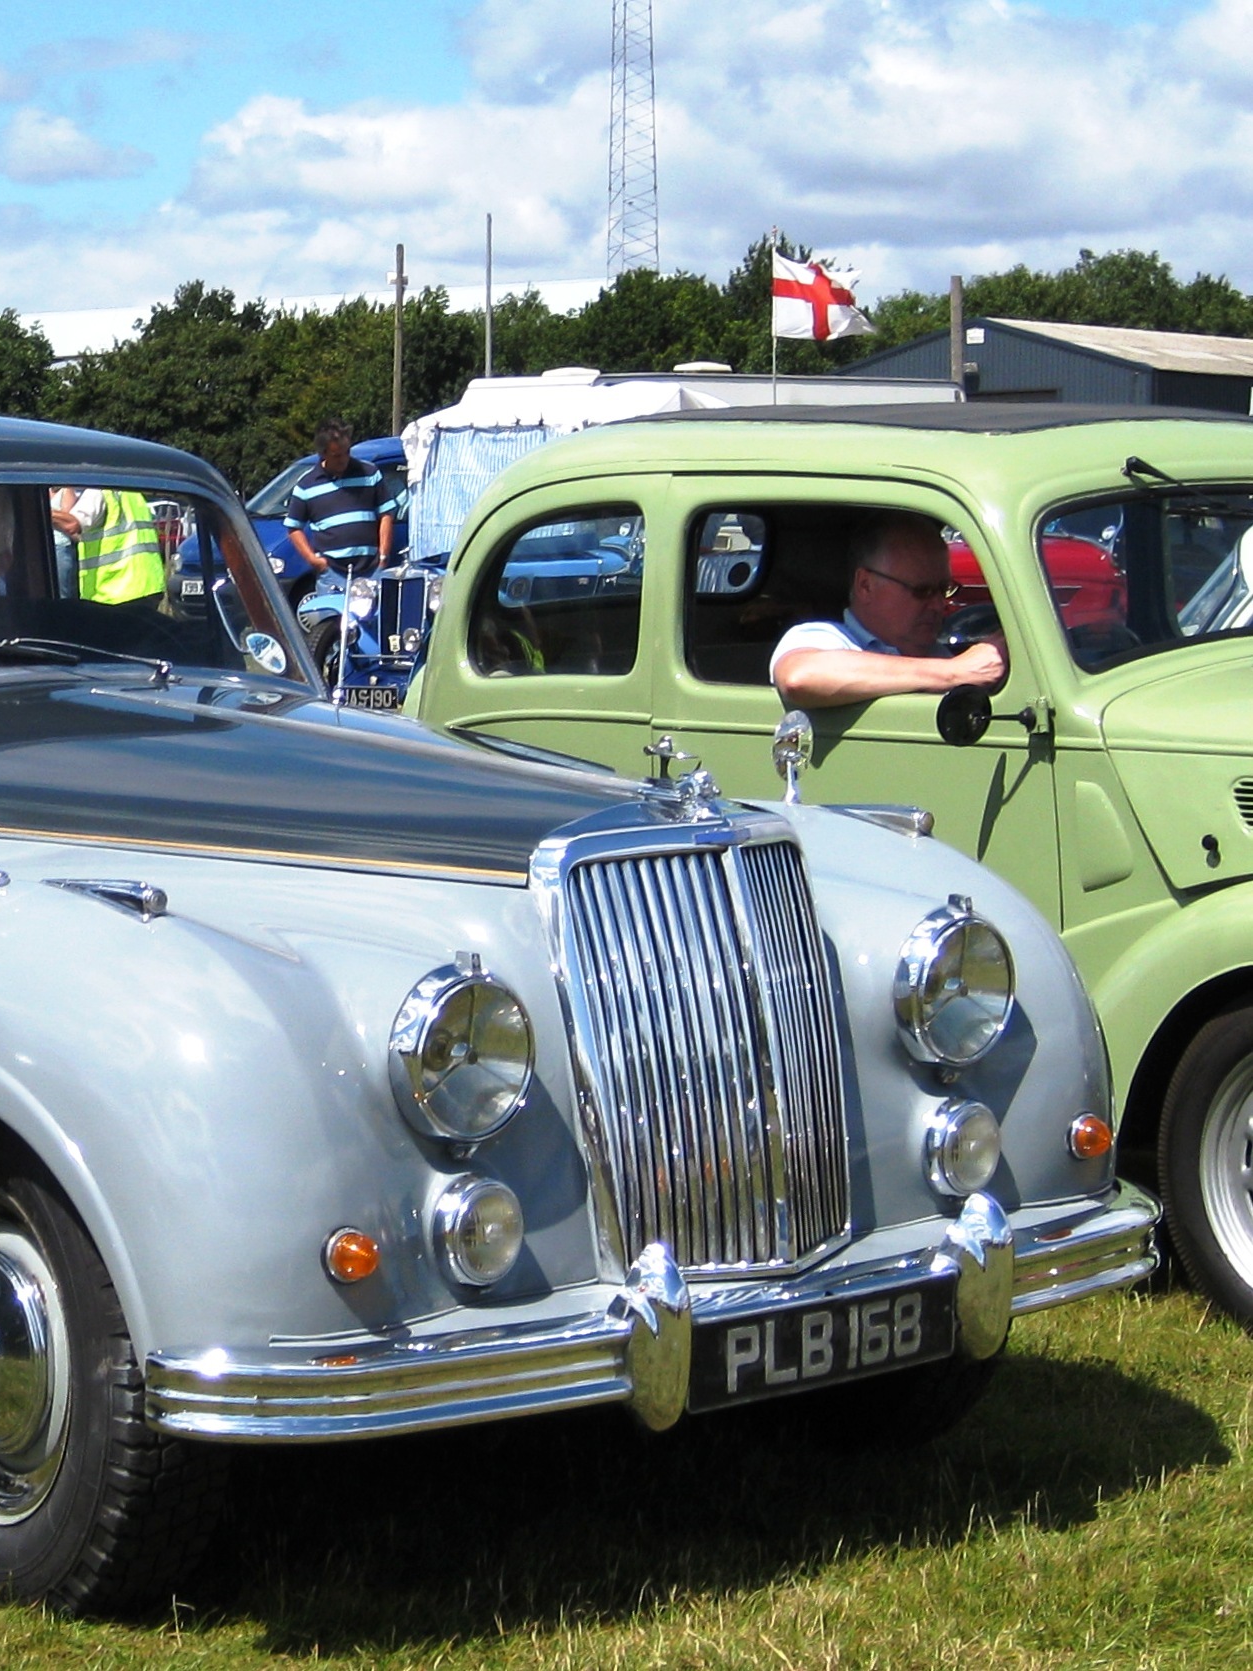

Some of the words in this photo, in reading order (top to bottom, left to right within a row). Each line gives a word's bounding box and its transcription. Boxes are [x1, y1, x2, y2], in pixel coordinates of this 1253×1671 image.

[370, 689, 392, 709] 190
[727, 1310, 834, 1394] PLB
[847, 1292, 922, 1369] 168
